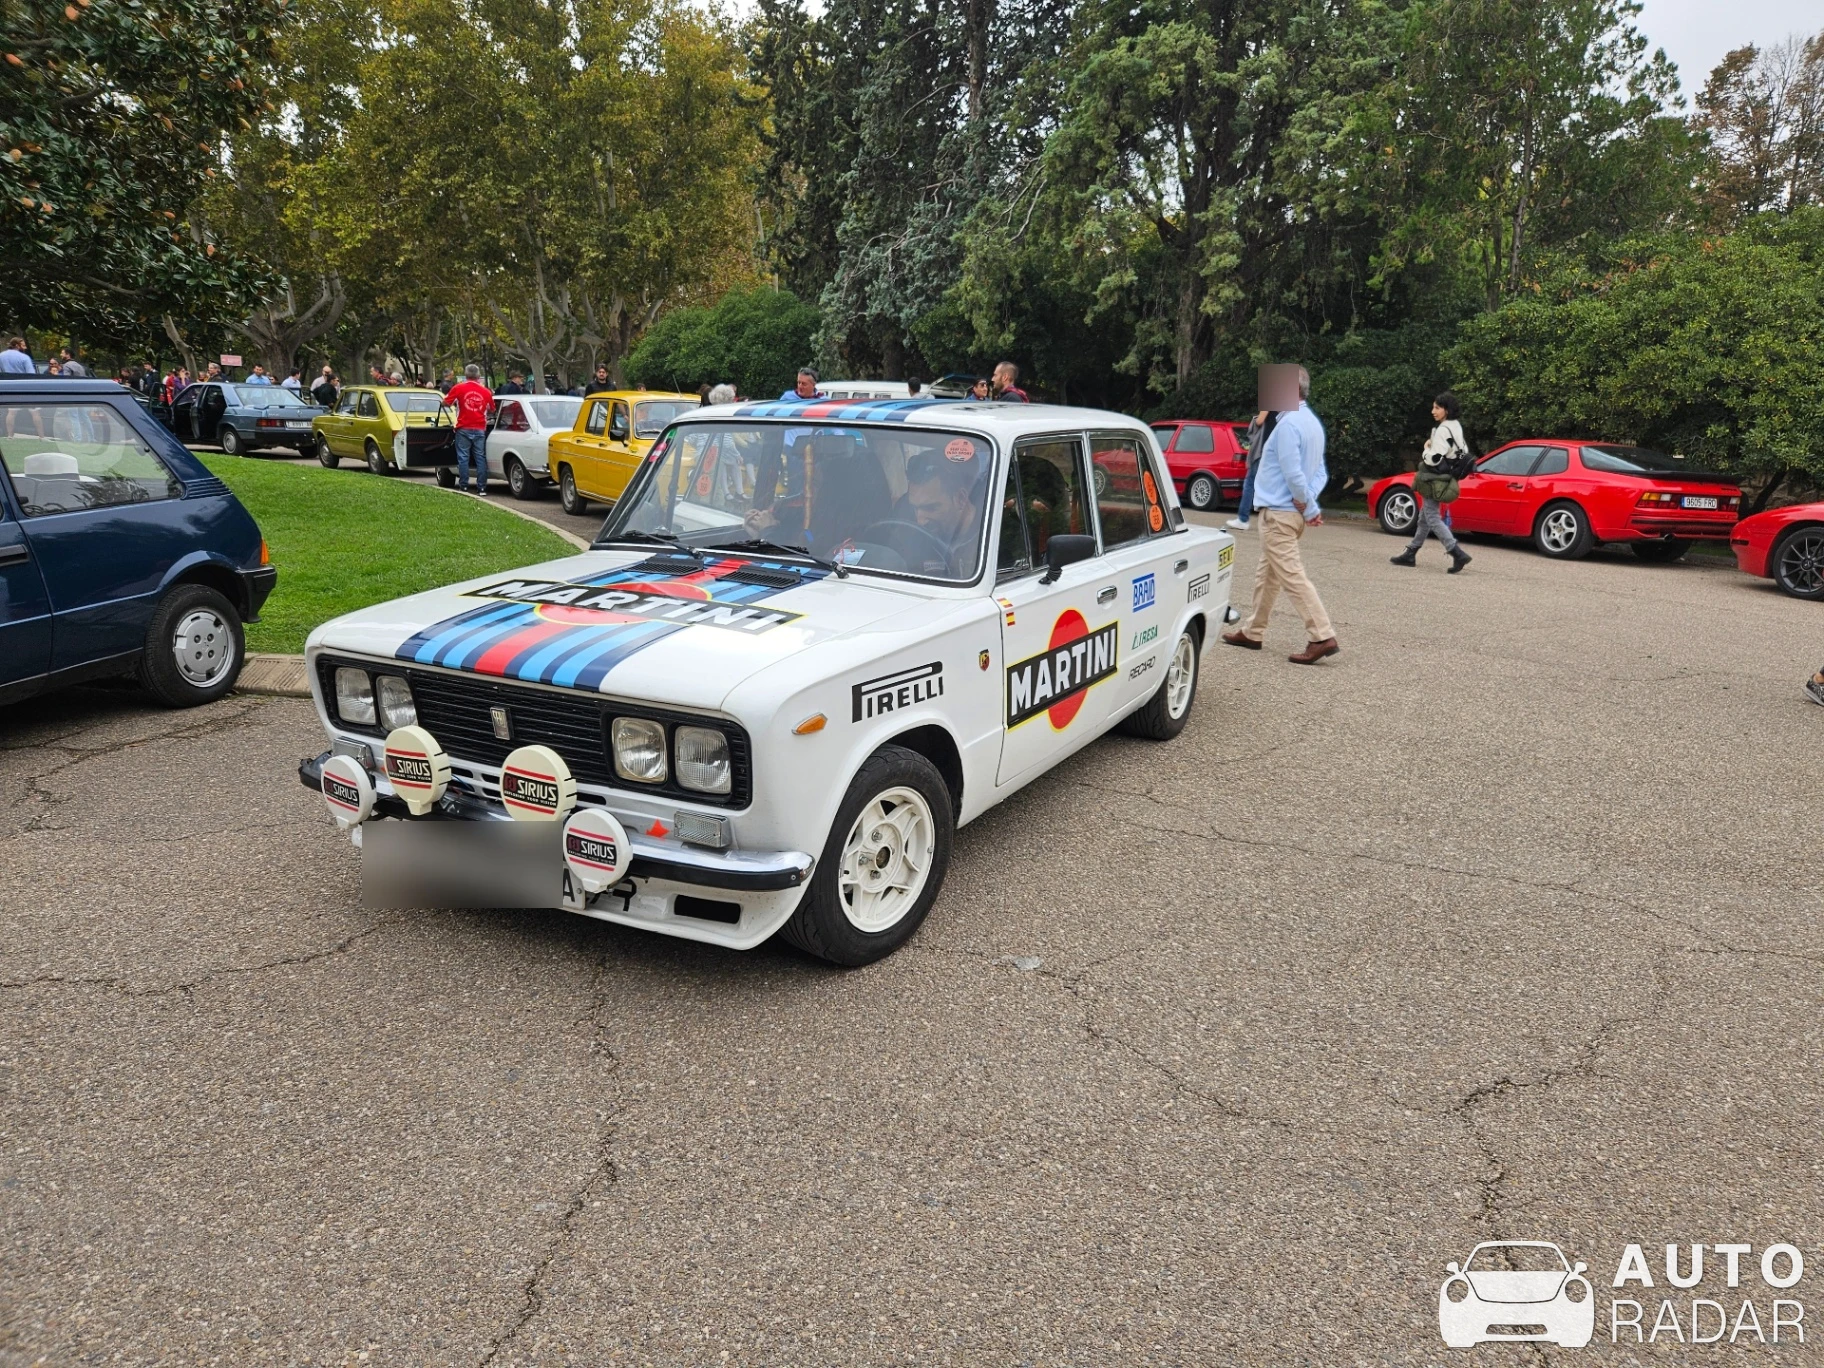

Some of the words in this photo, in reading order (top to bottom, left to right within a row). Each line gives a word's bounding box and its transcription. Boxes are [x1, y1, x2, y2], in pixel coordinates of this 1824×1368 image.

[1132, 578, 1155, 607] BRAID
[1187, 573, 1211, 603] PIRELLI
[478, 581, 787, 631] MARTINI
[1010, 627, 1117, 717] MARTINI
[1128, 655, 1156, 681] RECARO
[851, 660, 944, 723] PIRELLI
[396, 759, 431, 776] SIRIUS
[333, 783, 358, 801] SIRIUS
[517, 779, 557, 801] SIRIUS
[580, 840, 615, 860] SIRIUS
